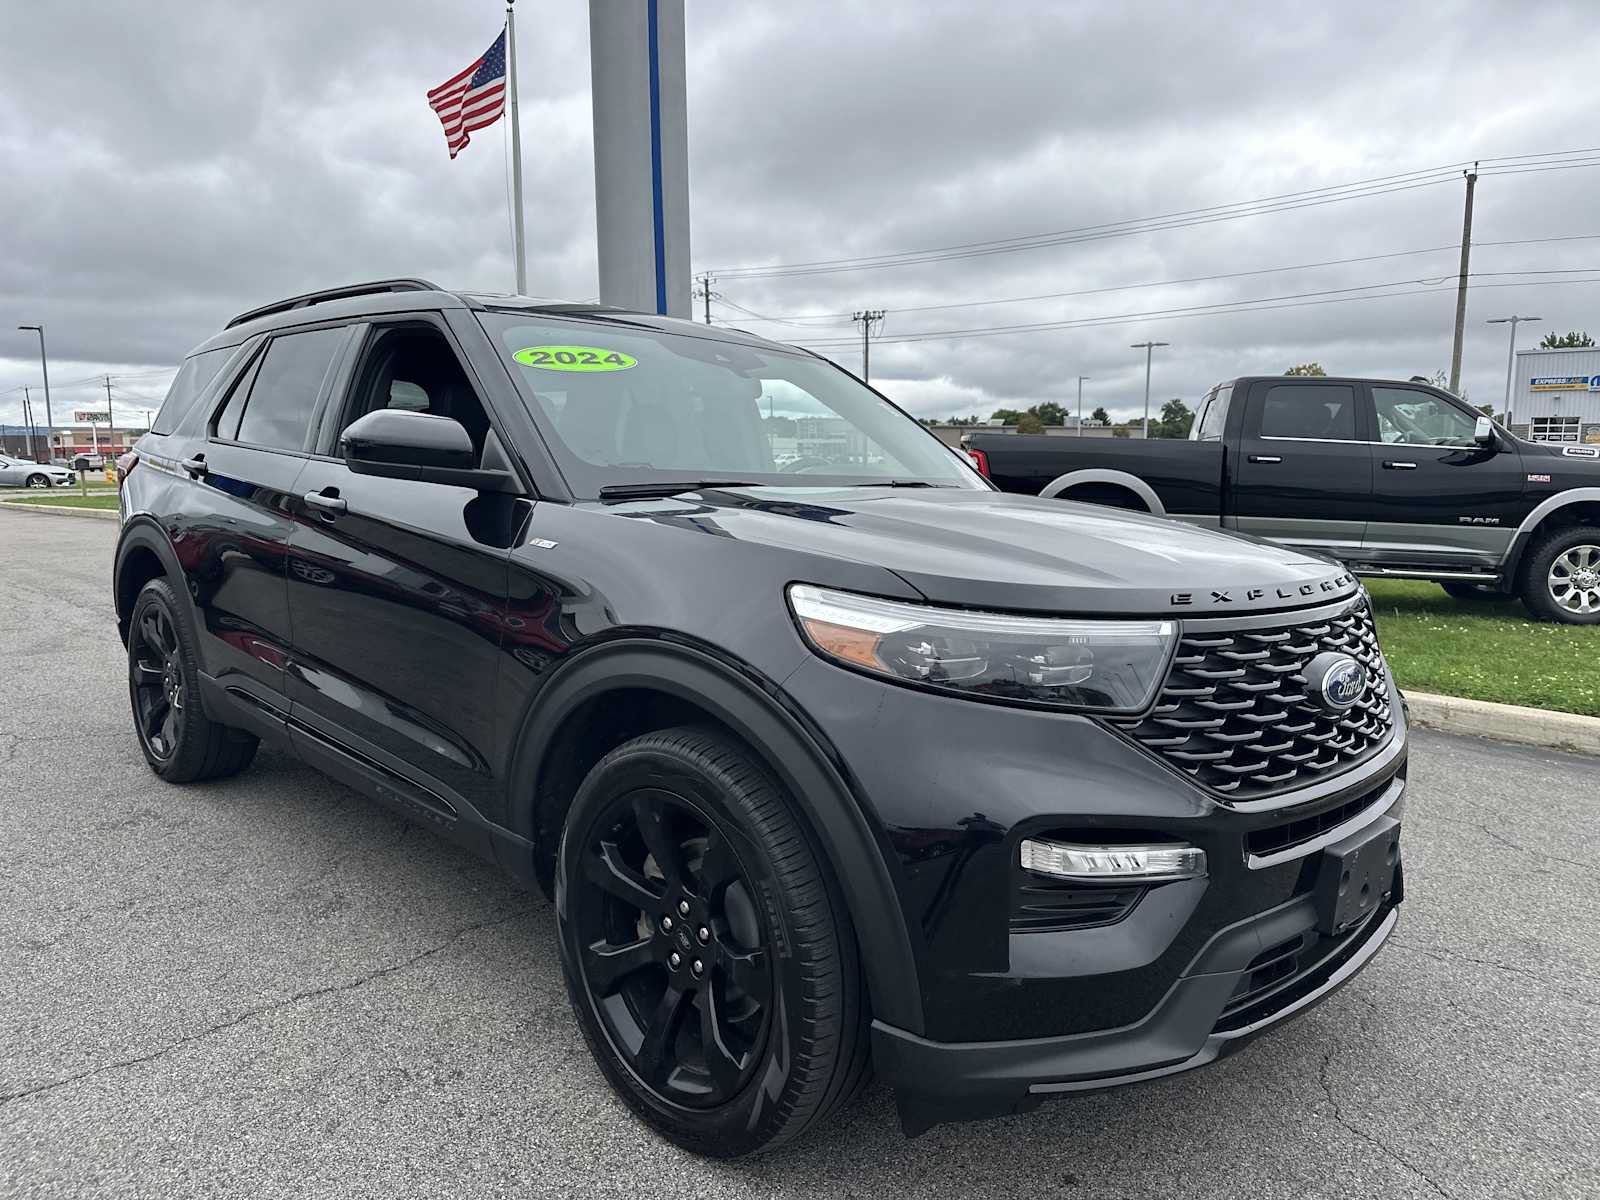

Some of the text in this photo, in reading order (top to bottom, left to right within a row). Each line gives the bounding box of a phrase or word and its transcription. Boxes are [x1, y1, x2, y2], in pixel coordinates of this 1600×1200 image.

[529, 351, 626, 366] 2024
[1459, 516, 1500, 524] RAM
[1337, 670, 1362, 697] Ford
